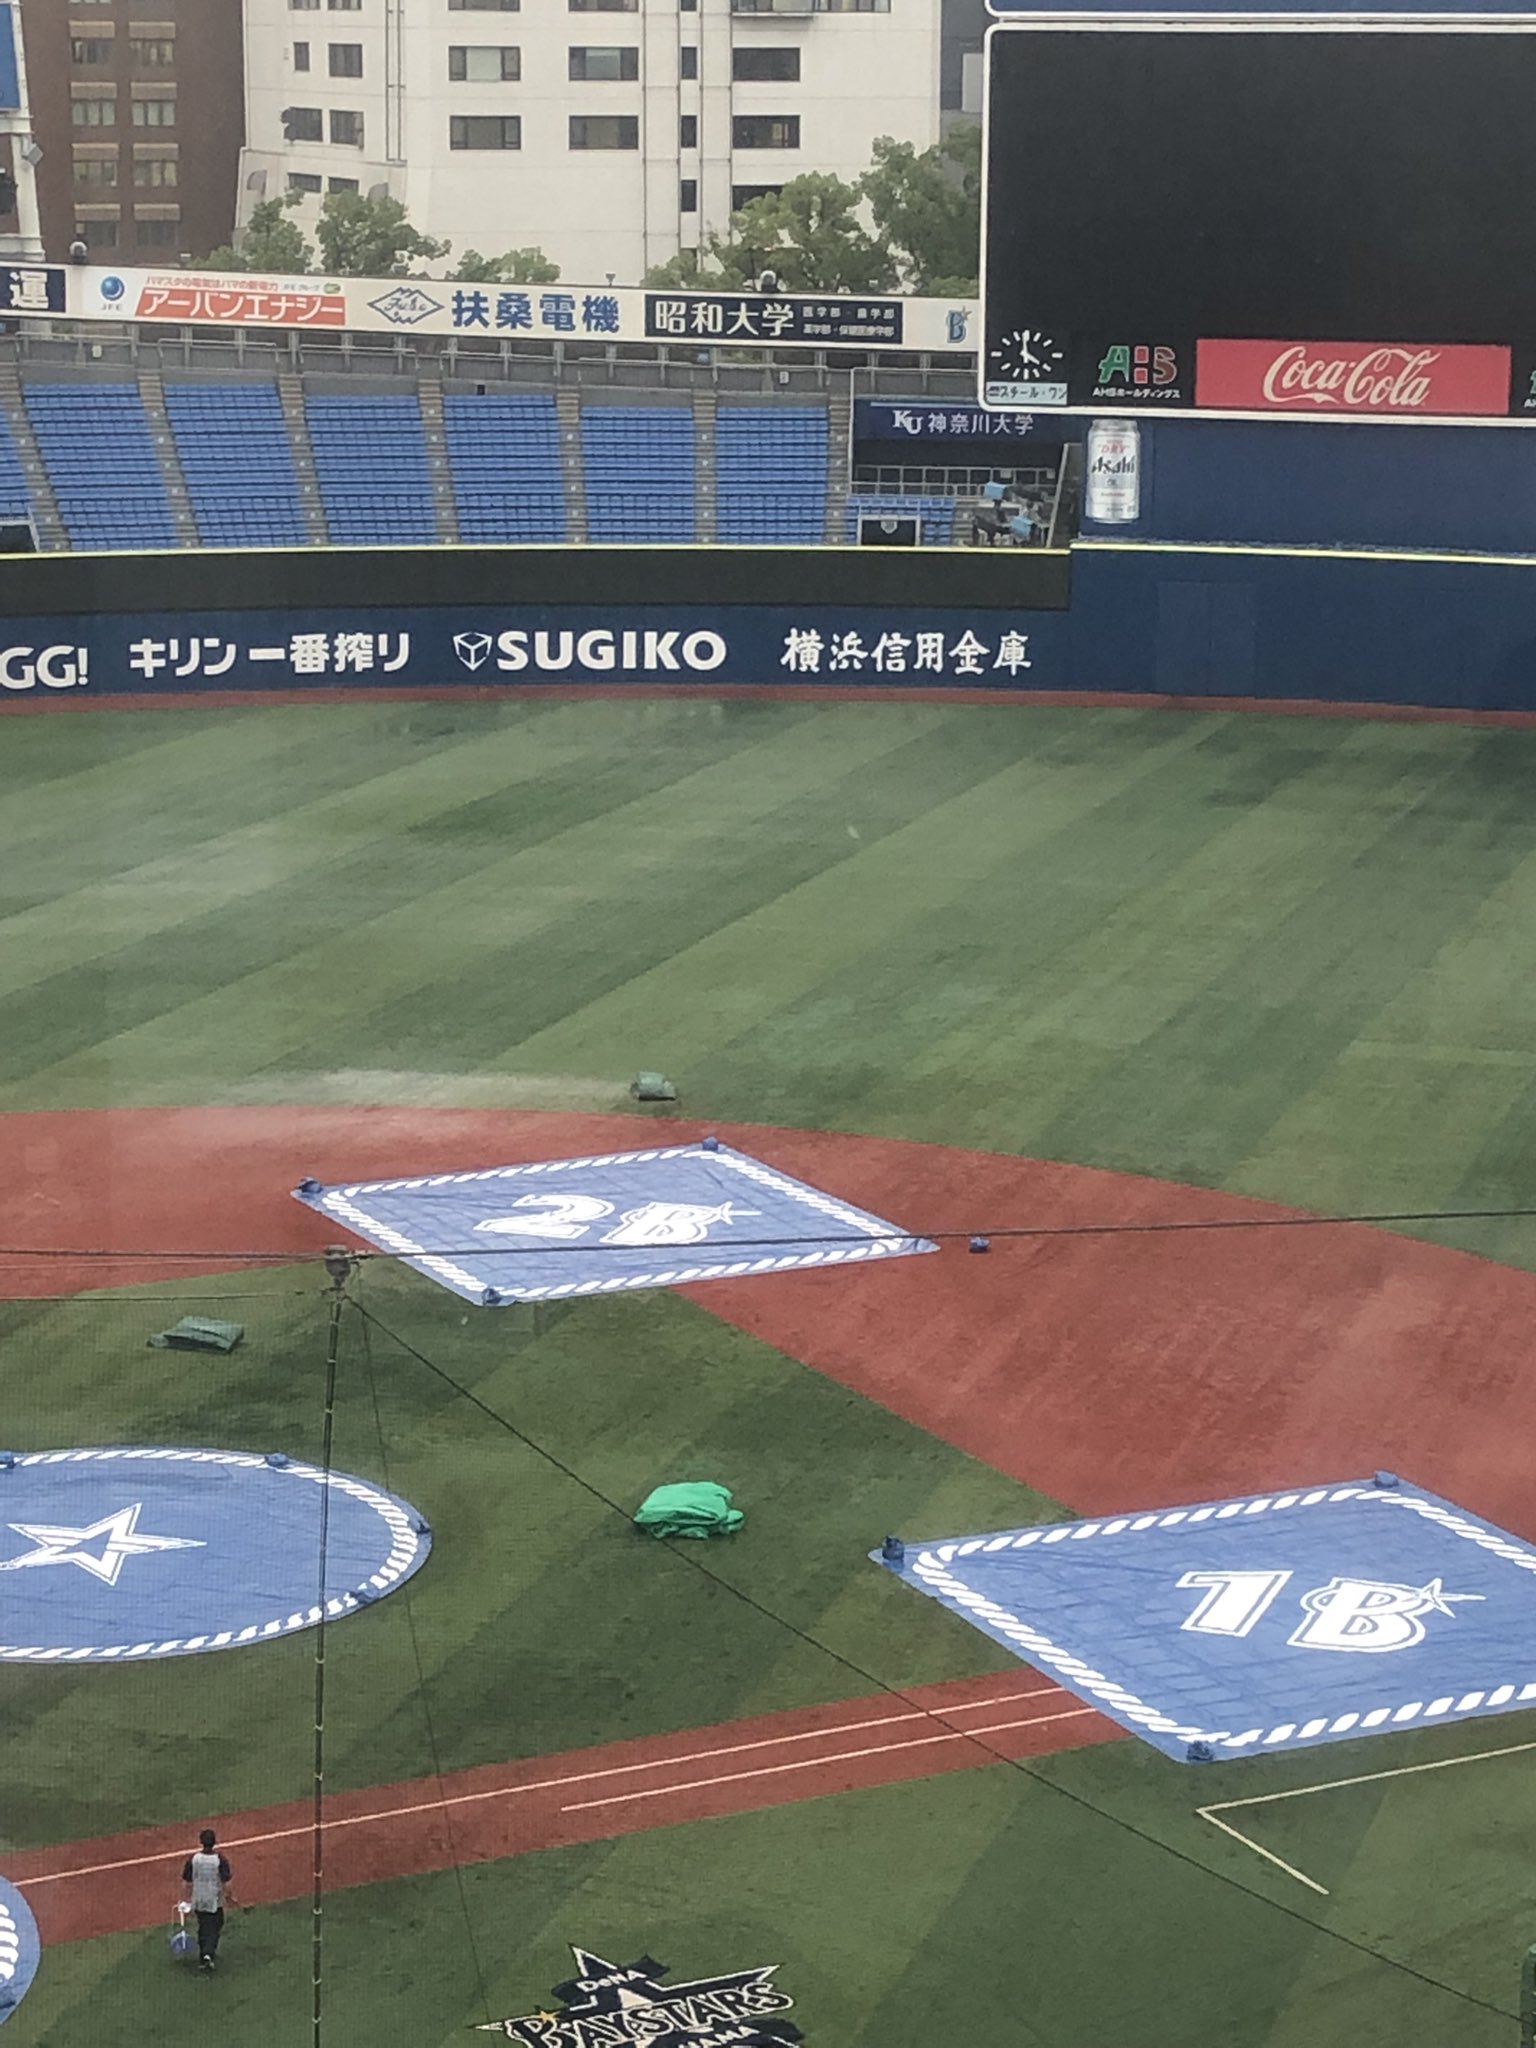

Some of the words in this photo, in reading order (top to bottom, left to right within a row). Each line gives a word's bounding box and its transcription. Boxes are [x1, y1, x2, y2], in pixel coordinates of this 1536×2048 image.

[9, 271, 49, 309] 運
[144, 289, 344, 321] アーバンエナジー
[451, 289, 621, 333] 扶桑電機
[654, 301, 795, 336] 昭和大学
[928, 412, 1034, 436] 神奈川大学
[1091, 456, 1136, 474] Asahi
[496, 630, 727, 671] SUGIKO
[780, 628, 1032, 676] 横浜信用金庫
